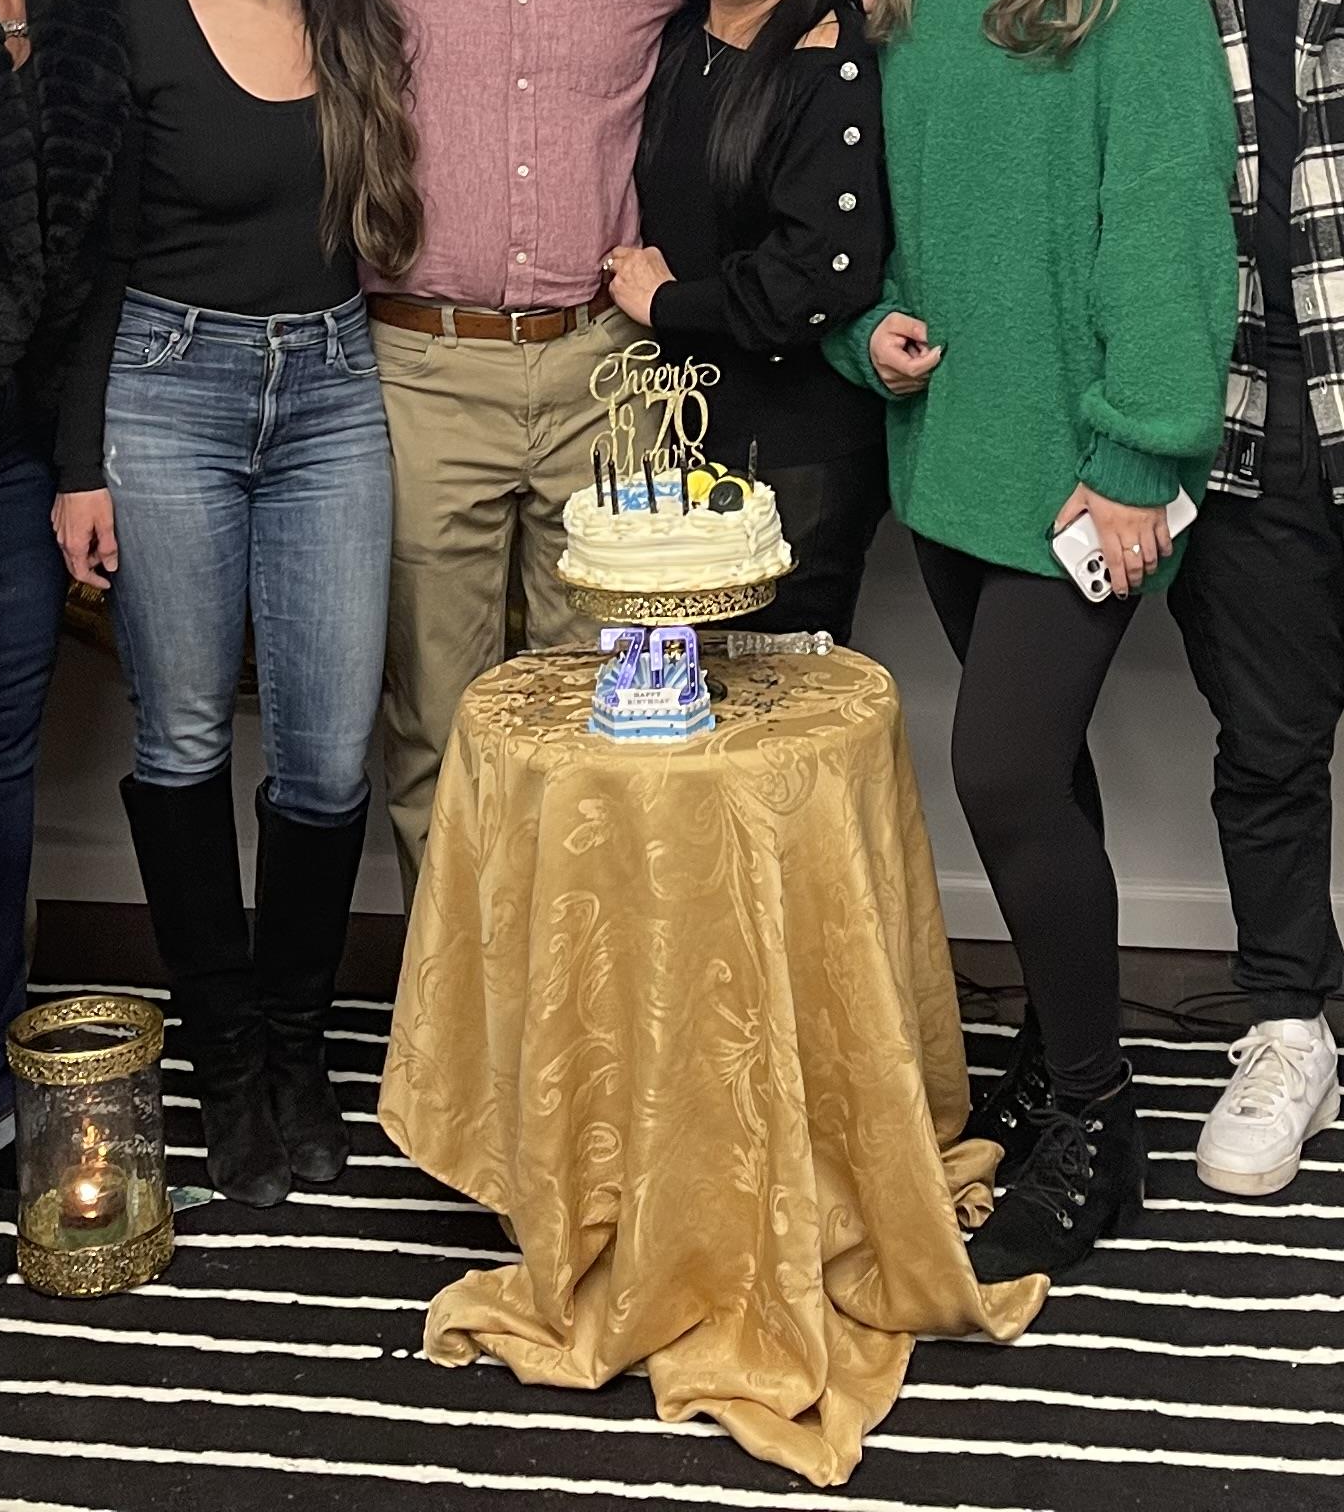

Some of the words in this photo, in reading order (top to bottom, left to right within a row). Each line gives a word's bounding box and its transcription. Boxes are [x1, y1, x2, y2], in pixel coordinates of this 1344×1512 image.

[589, 339, 721, 402] Cheers
[642, 389, 709, 448] 70
[599, 625, 701, 707] 70
